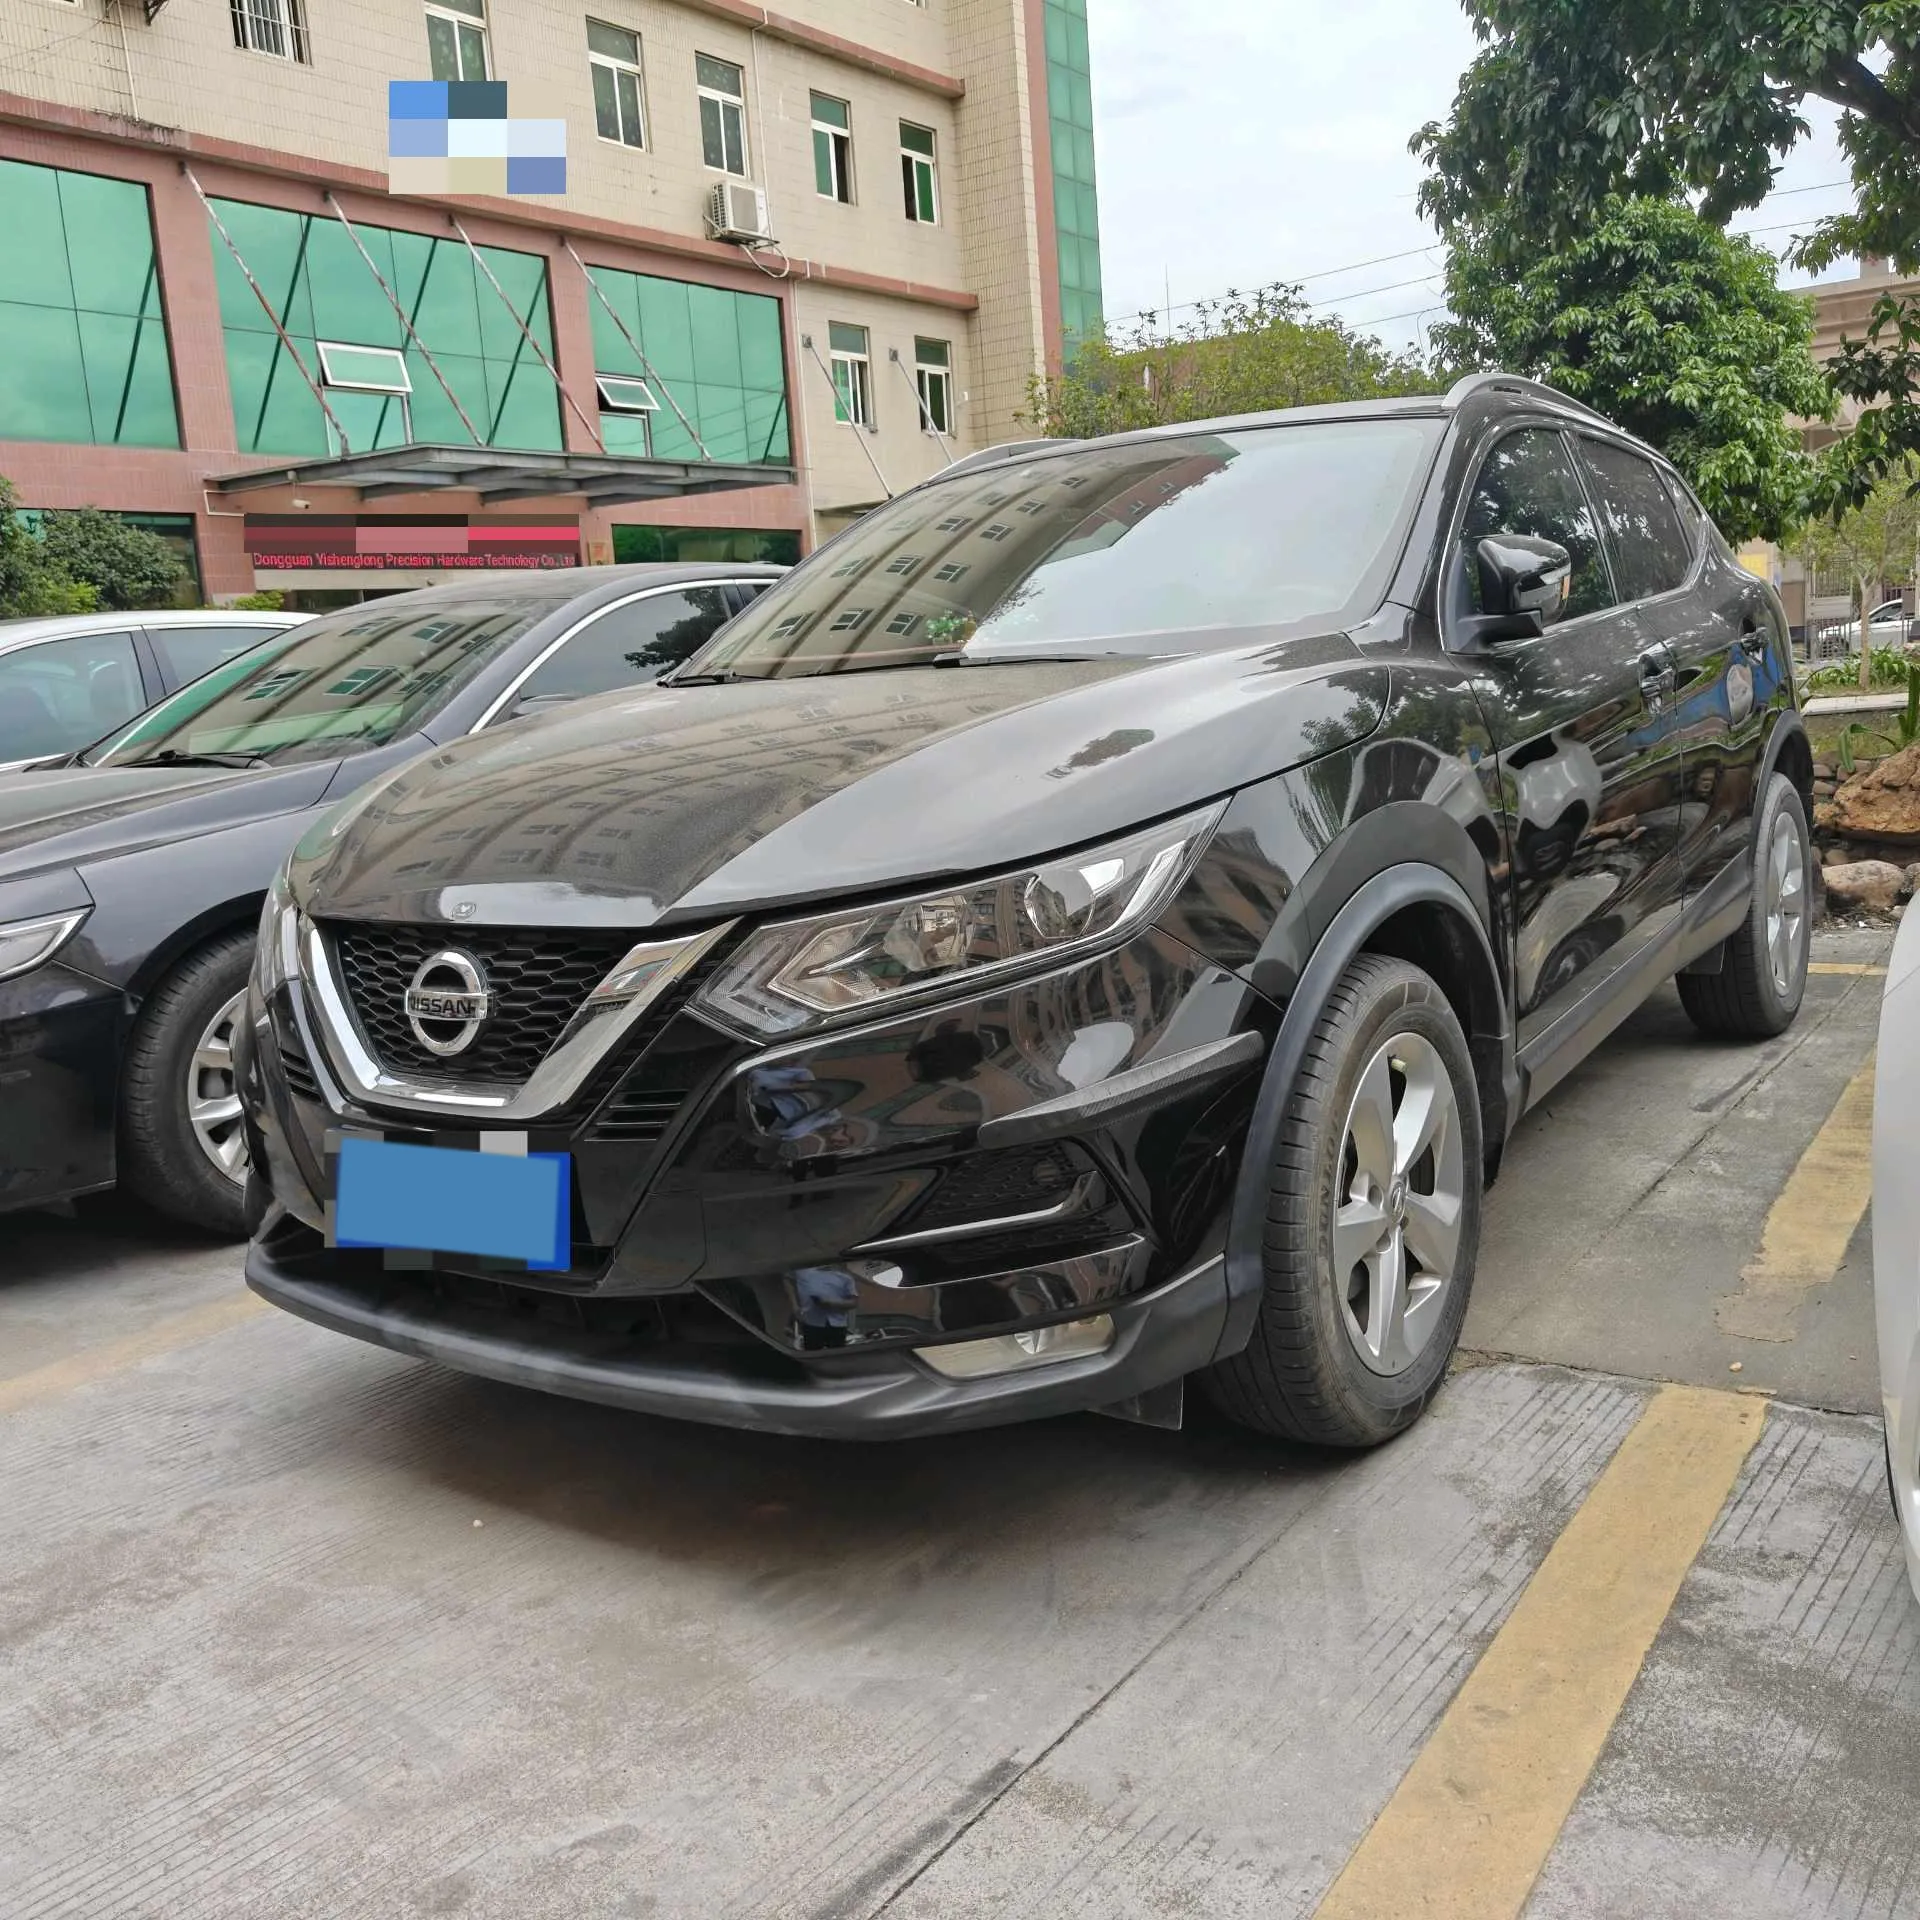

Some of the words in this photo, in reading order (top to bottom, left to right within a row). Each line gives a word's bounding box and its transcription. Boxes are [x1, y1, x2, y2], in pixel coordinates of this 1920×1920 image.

[253, 553, 313, 568] Dongguan
[386, 553, 434, 567] Precision
[436, 553, 484, 567] Hardware
[484, 553, 539, 569] Technology
[410, 995, 473, 1014] NISSAN
